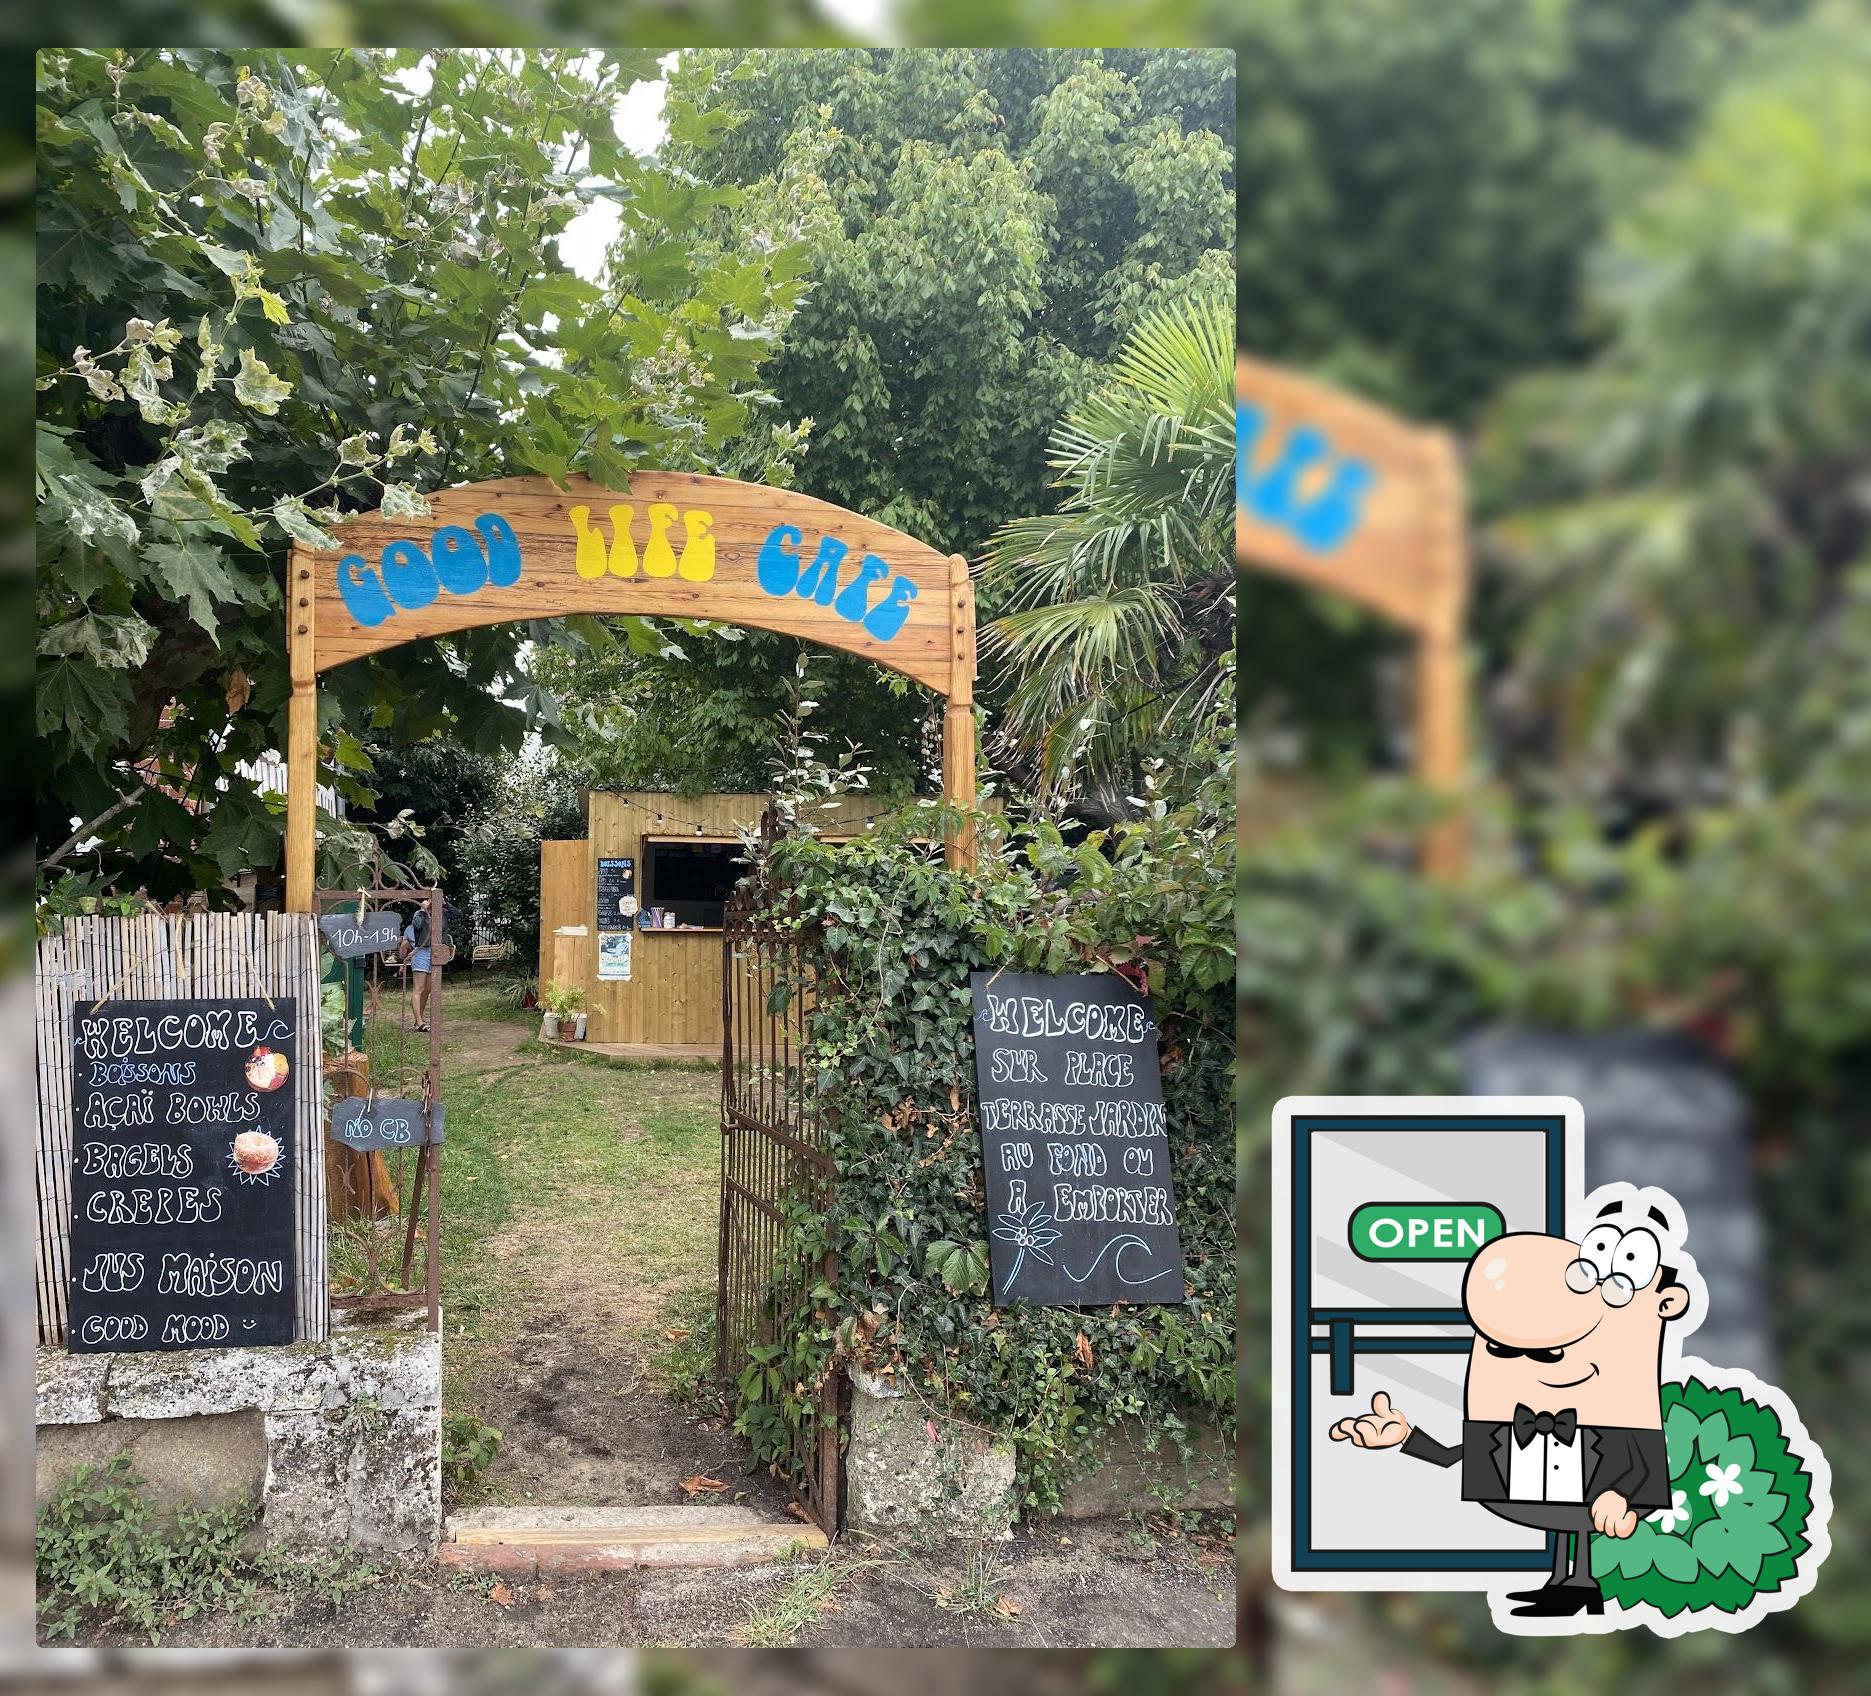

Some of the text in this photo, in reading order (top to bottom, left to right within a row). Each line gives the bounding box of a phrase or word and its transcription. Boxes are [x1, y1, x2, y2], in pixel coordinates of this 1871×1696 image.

[336, 503, 918, 642] GOOD LIFE CAFE
[331, 927, 398, 948] 10h-19h
[81, 1010, 258, 1060] WELCOME
[986, 994, 1146, 1044] WELCOME
[991, 1047, 1134, 1087] SUR PLACE
[165, 1092, 261, 1125] BOWLS
[980, 1098, 1169, 1139] TERRASSE JARDIN
[345, 1118, 411, 1144] NO CB
[82, 1142, 194, 1180] BAGELS
[1001, 1142, 1154, 1177] AU FOND OU
[86, 1187, 222, 1225] CREPES
[1008, 1179, 1174, 1226] A EMPORTER
[82, 1253, 146, 1293] JUS
[81, 1313, 230, 1345] GOOD MOOD
